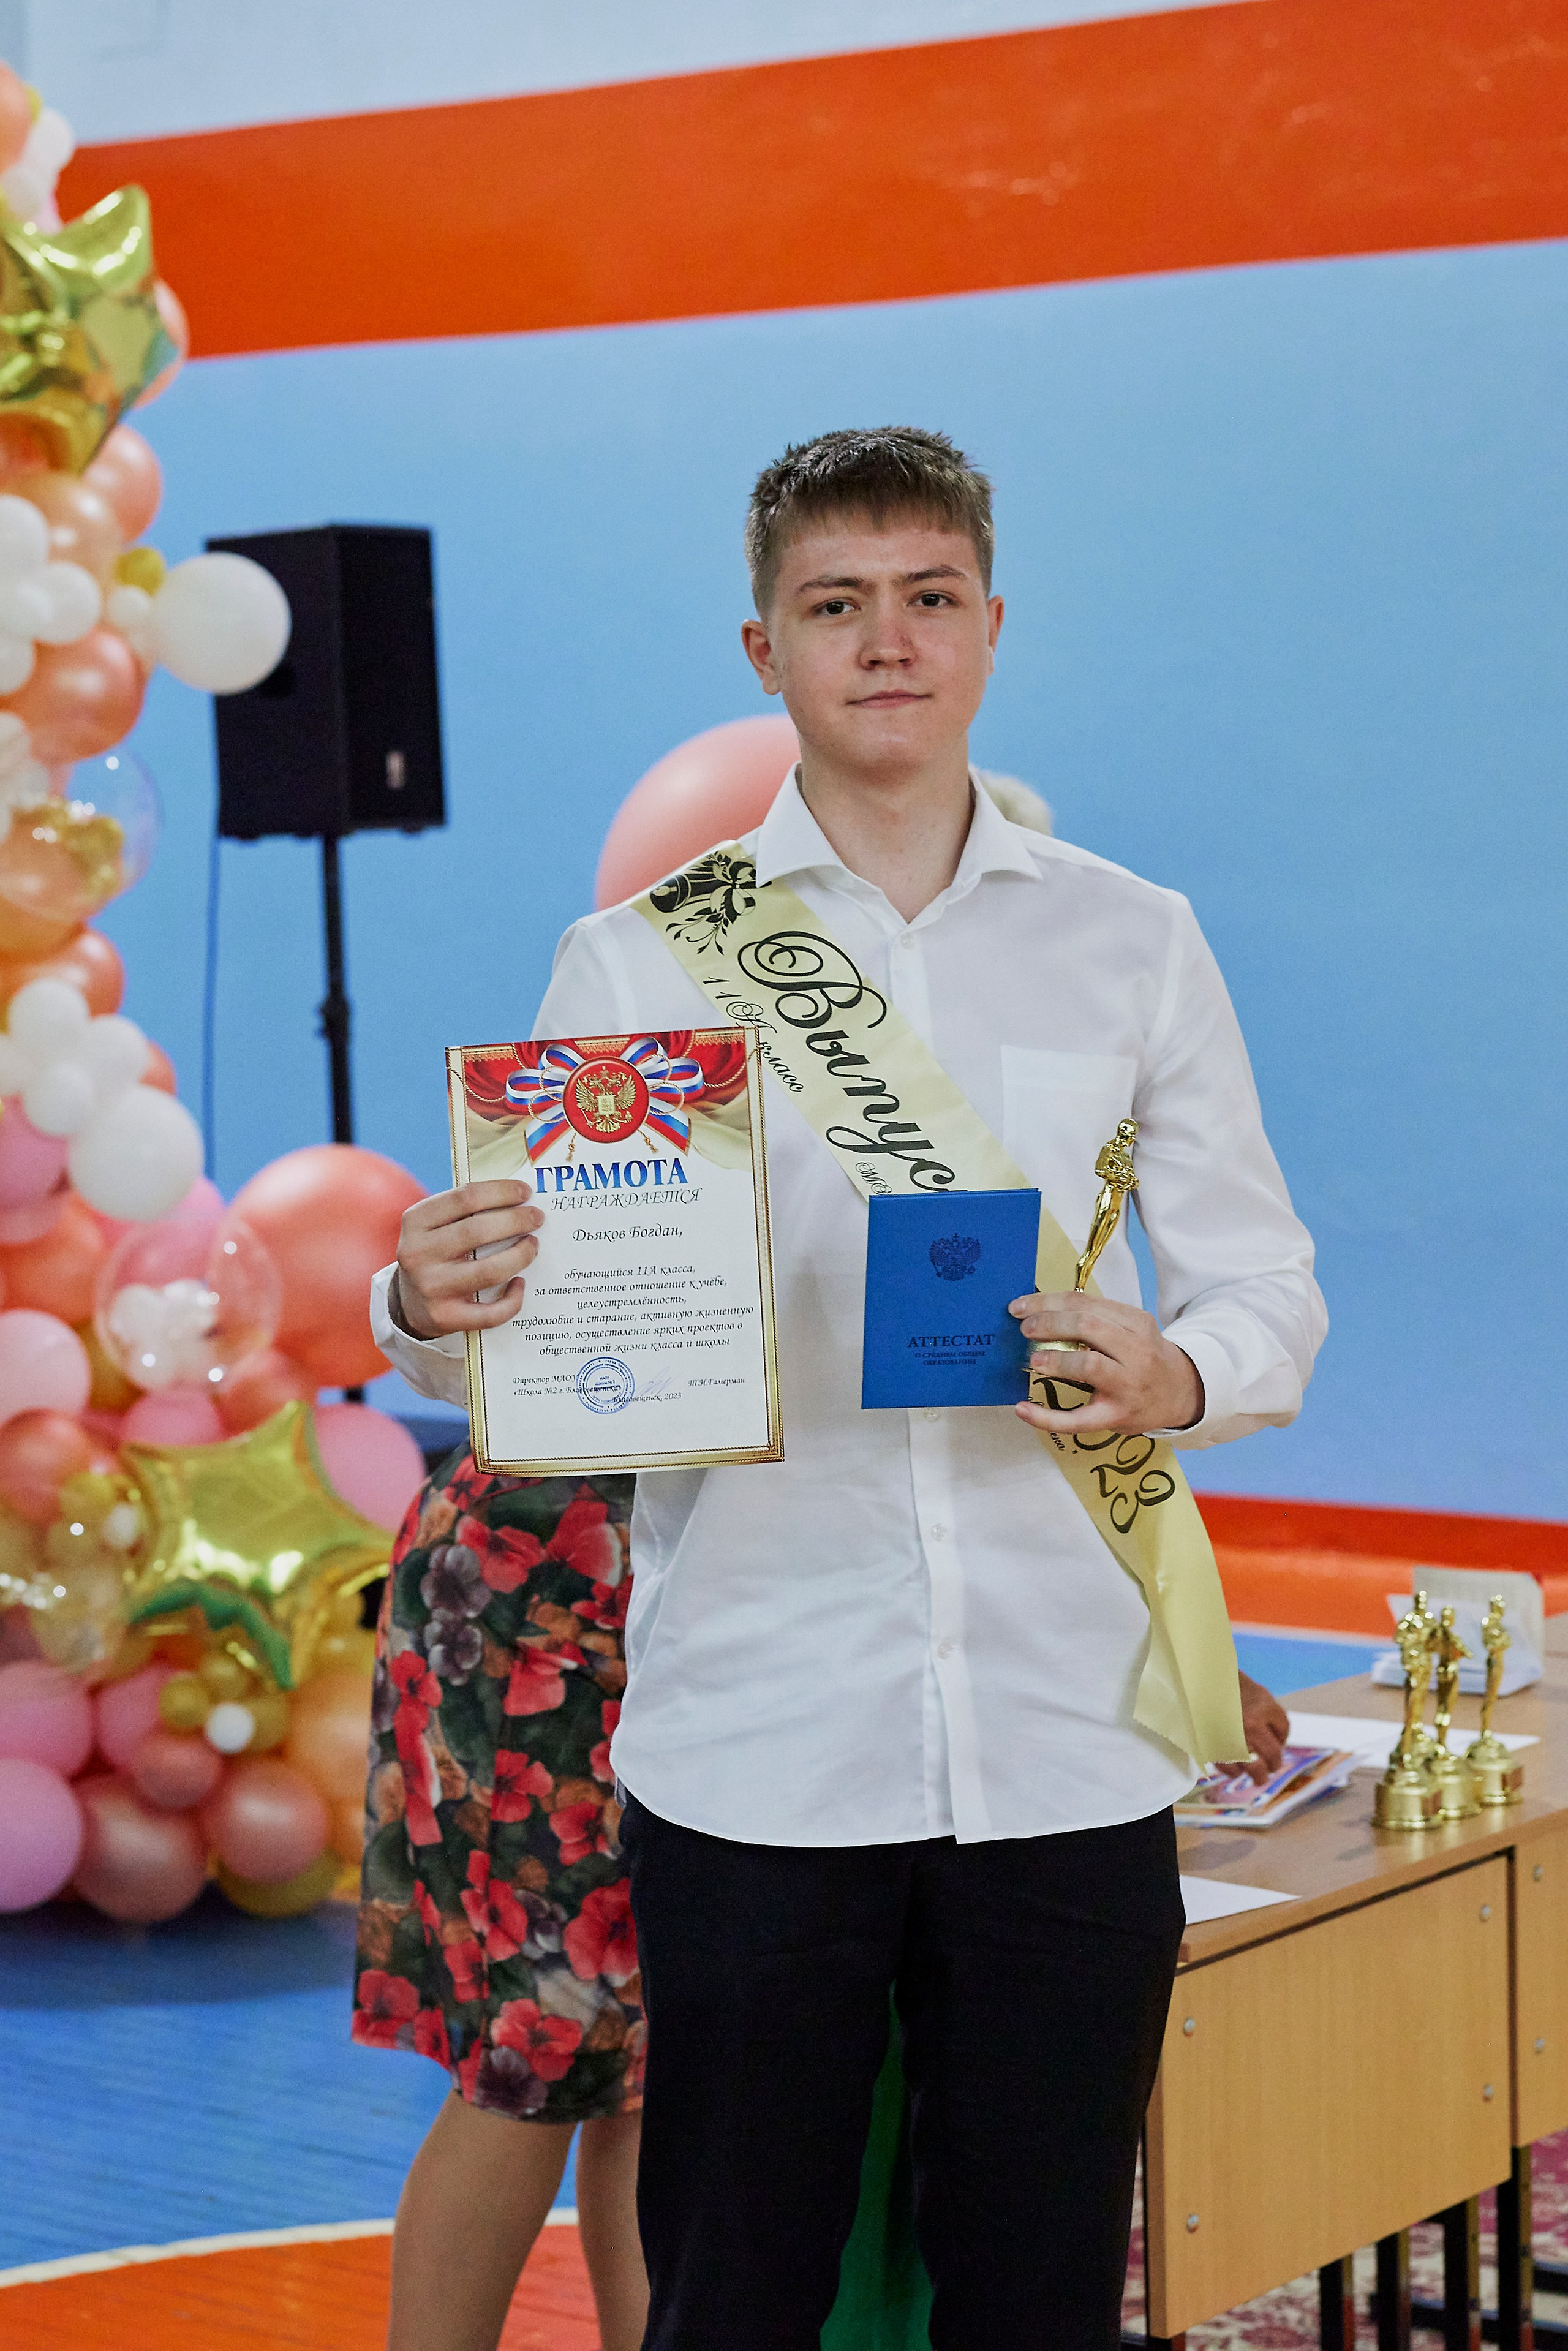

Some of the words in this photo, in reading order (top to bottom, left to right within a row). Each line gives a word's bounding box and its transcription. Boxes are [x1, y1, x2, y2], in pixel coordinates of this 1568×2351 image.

[737, 930, 968, 1191] Выпус
[535, 1158, 688, 1193] ГРАМОТА
[551, 1188, 702, 1210] НАГРАЖДАЕТСЯ
[573, 1229, 625, 1242] Дьяков
[629, 1223, 682, 1238] Богдан,
[564, 1269, 633, 1281] обучающийся
[637, 1266, 657, 1275] 11А
[660, 1266, 696, 1277] класса,
[534, 1288, 545, 1296] за
[548, 1283, 627, 1295] ответственное
[630, 1280, 686, 1290] отношение
[689, 1280, 696, 1289] к
[696, 1277, 727, 1289] учёбе,
[577, 1297, 687, 1310] целеустремлённость,
[512, 1314, 574, 1329] трудолюбие
[586, 1313, 637, 1325] старание,
[640, 1310, 692, 1321] активную
[695, 1306, 754, 1318] жизненную
[526, 1331, 572, 1342] позицию,
[575, 1327, 650, 1341] осуществление
[653, 1326, 685, 1337] ярких
[687, 1323, 734, 1335] проектов
[908, 1334, 995, 1347] АТТЕСТАТ
[540, 1345, 611, 1357] общественной
[614, 1343, 647, 1353] жизни
[650, 1340, 682, 1350] класса
[696, 1337, 729, 1347] школы
[513, 1376, 549, 1385] Директор
